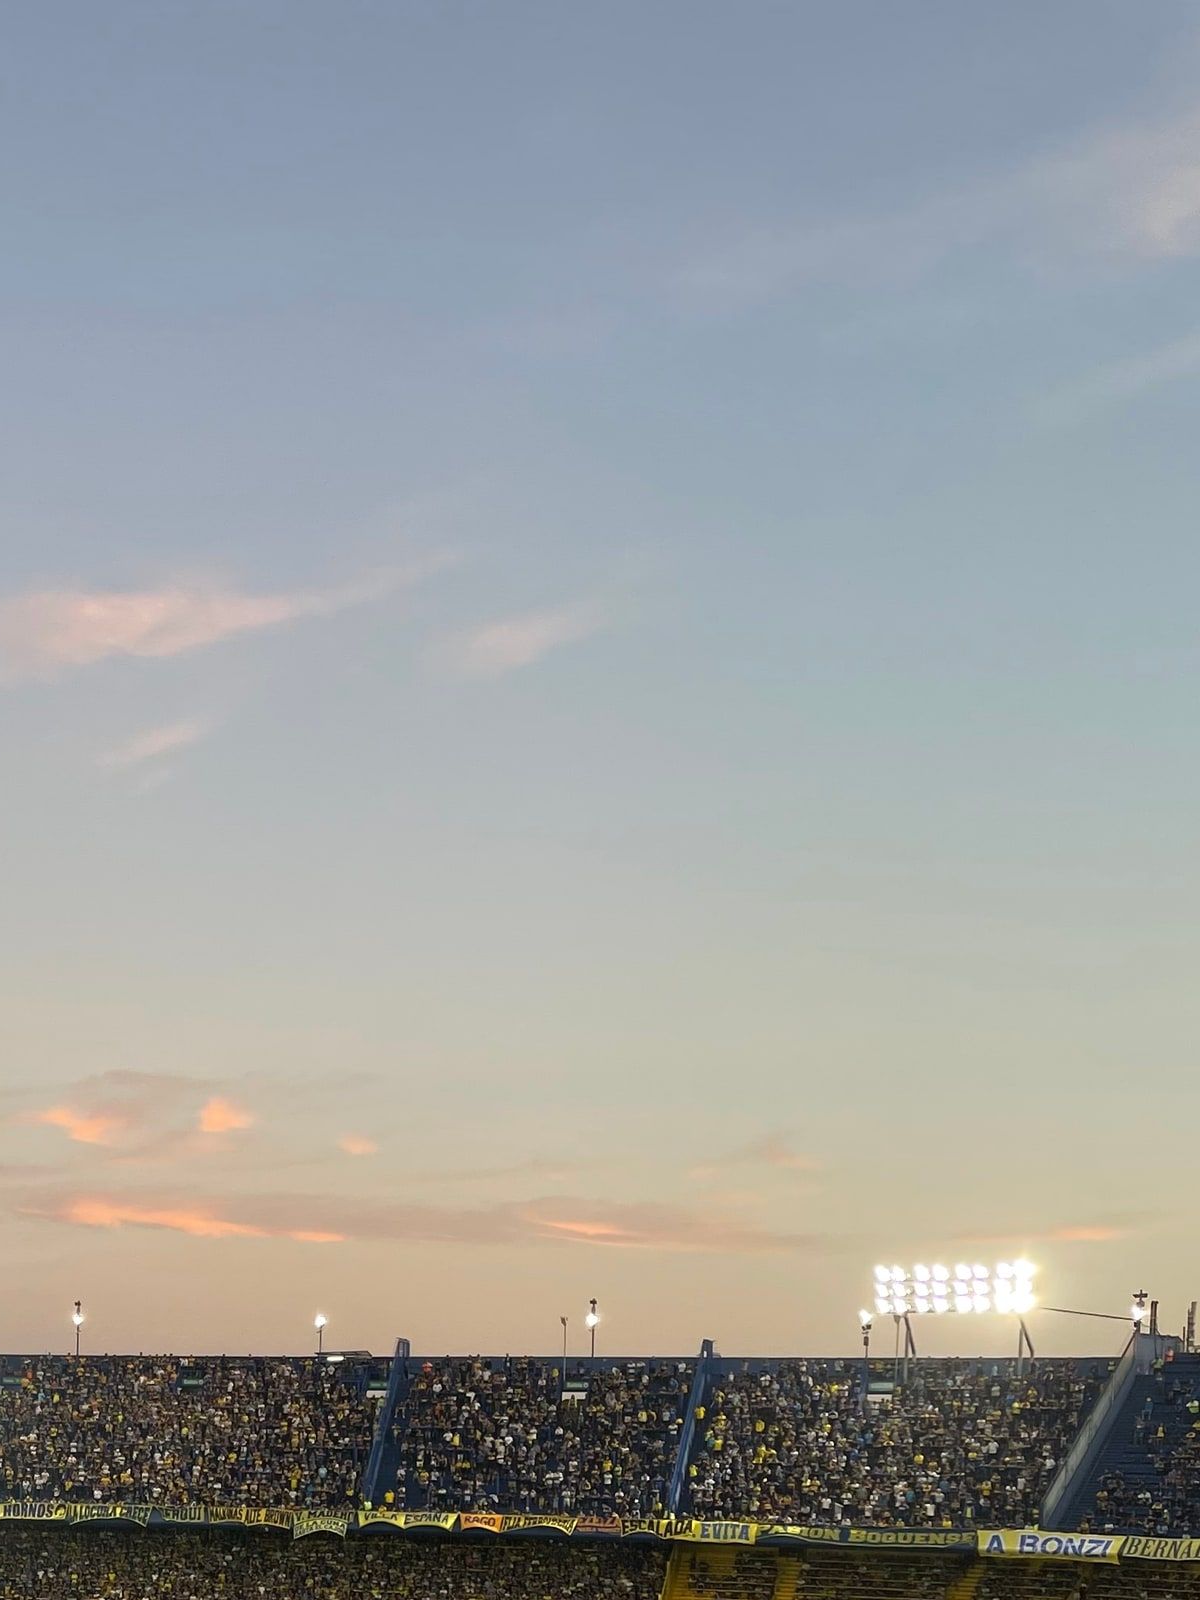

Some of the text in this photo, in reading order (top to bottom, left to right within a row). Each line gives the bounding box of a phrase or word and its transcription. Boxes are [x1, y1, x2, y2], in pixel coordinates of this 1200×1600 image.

[4, 1504, 53, 1518] HORNOS
[701, 1523, 750, 1540] EVITA
[986, 1534, 1113, 1557] A BONZI
